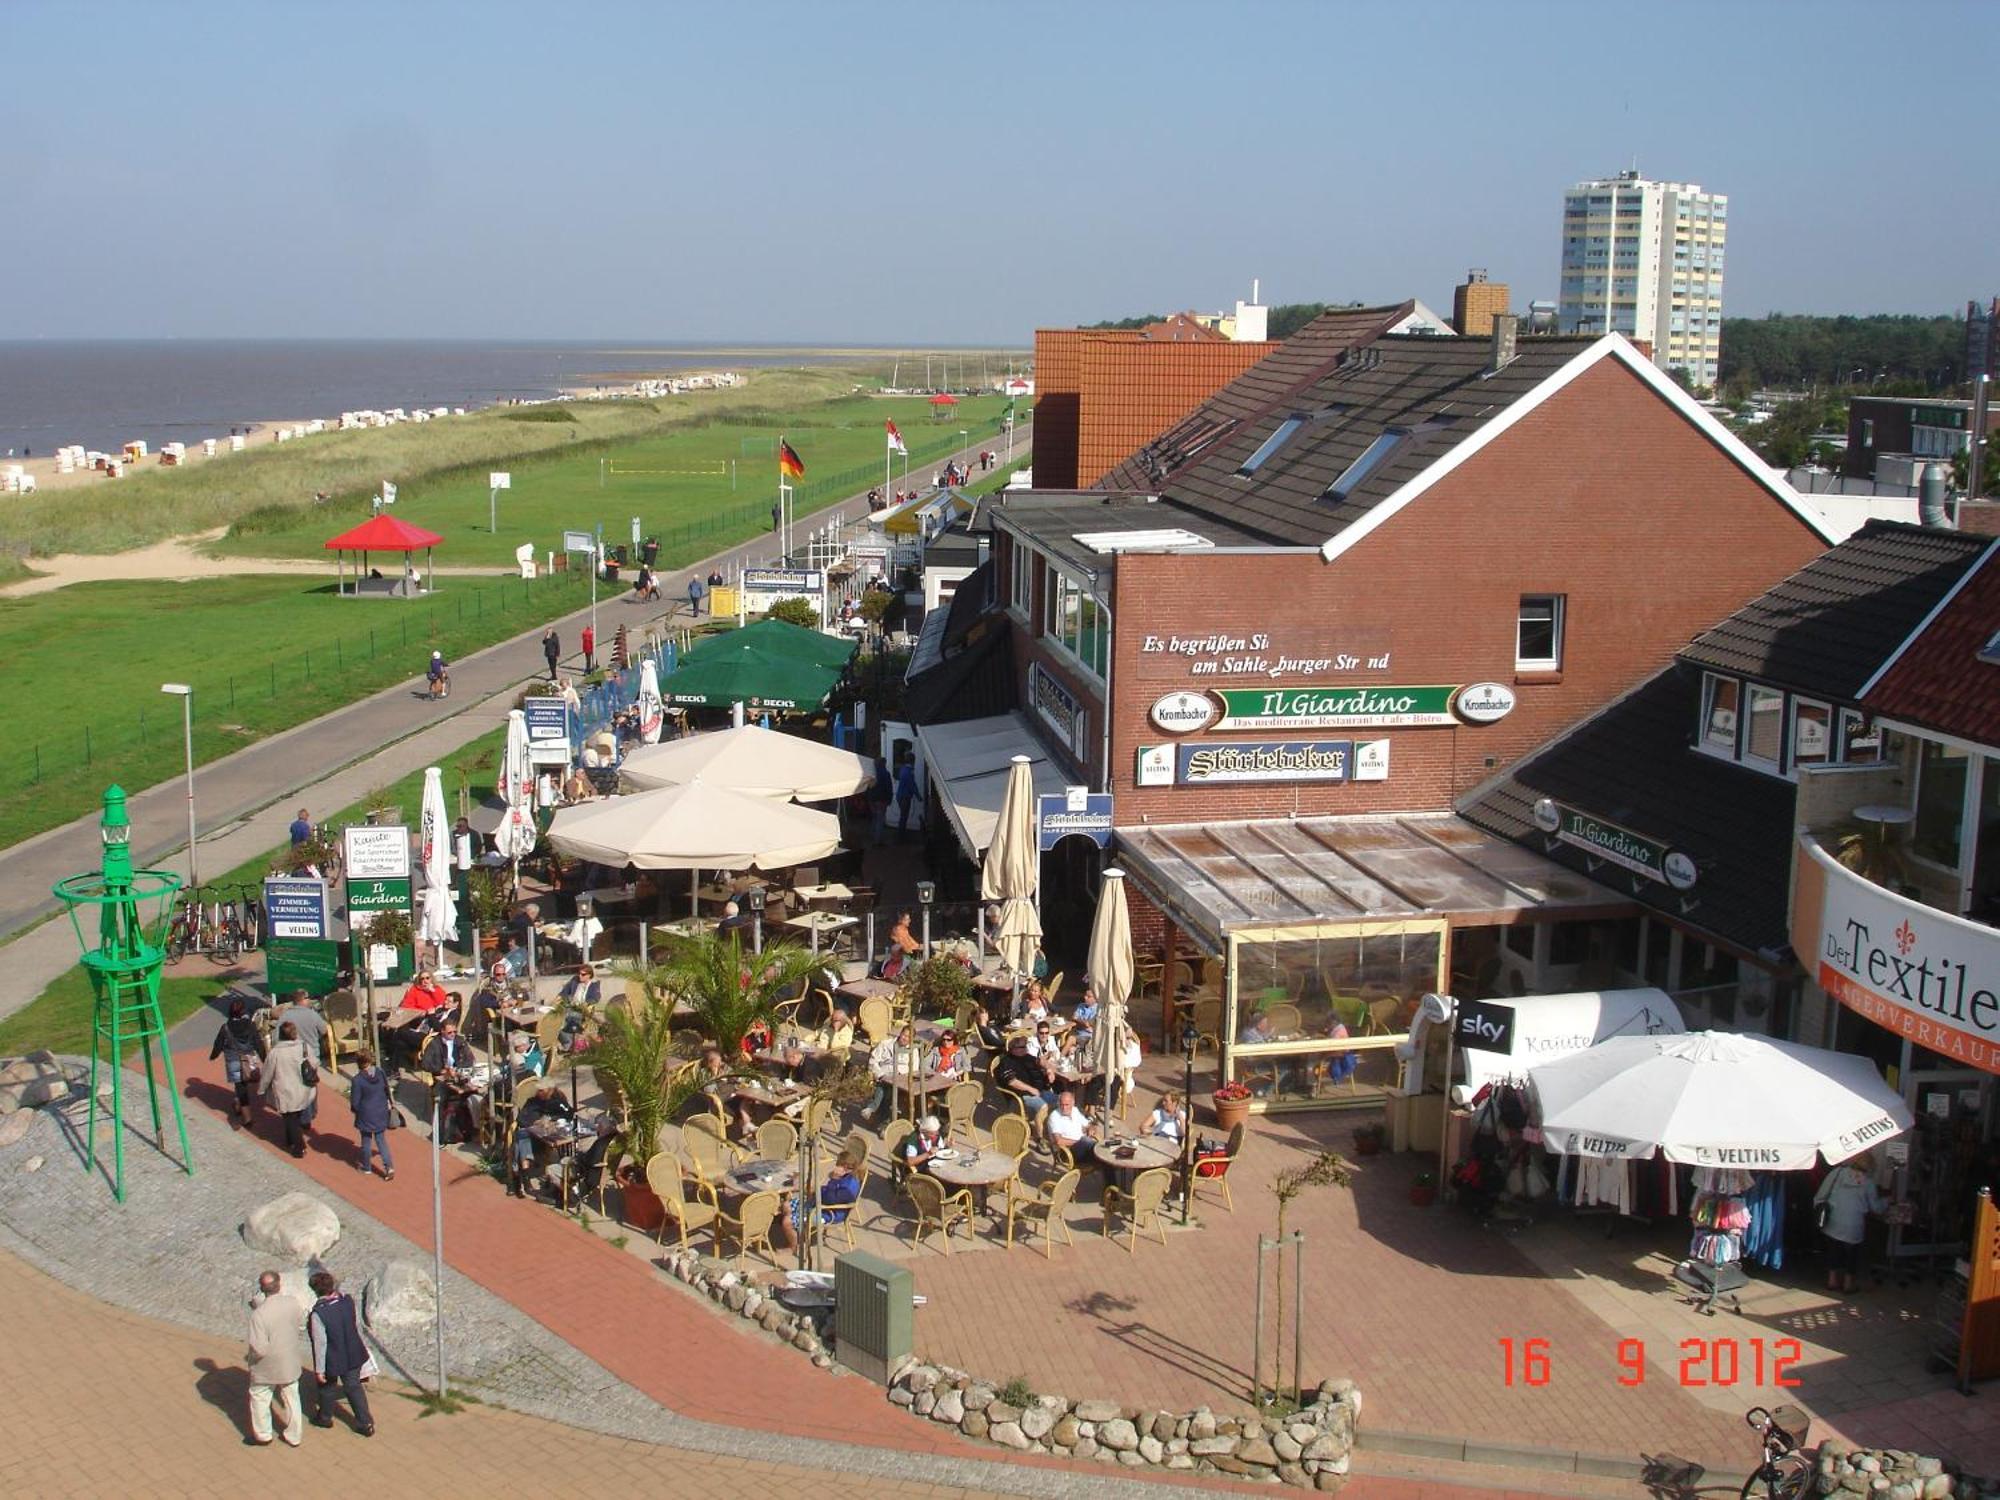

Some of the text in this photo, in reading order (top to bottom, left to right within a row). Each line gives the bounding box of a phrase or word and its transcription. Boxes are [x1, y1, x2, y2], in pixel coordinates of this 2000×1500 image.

[1143, 634, 1269, 655] Es begrüßen Si
[1193, 660, 1217, 674] am
[1335, 653, 1389, 671] Strnd
[1261, 690, 1418, 717] Il Giardino
[1464, 699, 1511, 711] Krombacher
[1159, 708, 1208, 721] Krombacher
[1319, 716, 1373, 726] Restaurant
[1413, 714, 1442, 724] Bistro
[1187, 744, 1345, 779] Störtebeker
[1586, 823, 1651, 863] Giardino
[373, 882, 386, 893] Il
[350, 893, 408, 905] Giardino
[288, 925, 318, 934] VELTINS
[1827, 917, 1999, 1031] Der Textile
[1462, 1013, 1505, 1043] sky
[1852, 1116, 1895, 1144] VELTINS
[1718, 1148, 1780, 1164] VELTINS
